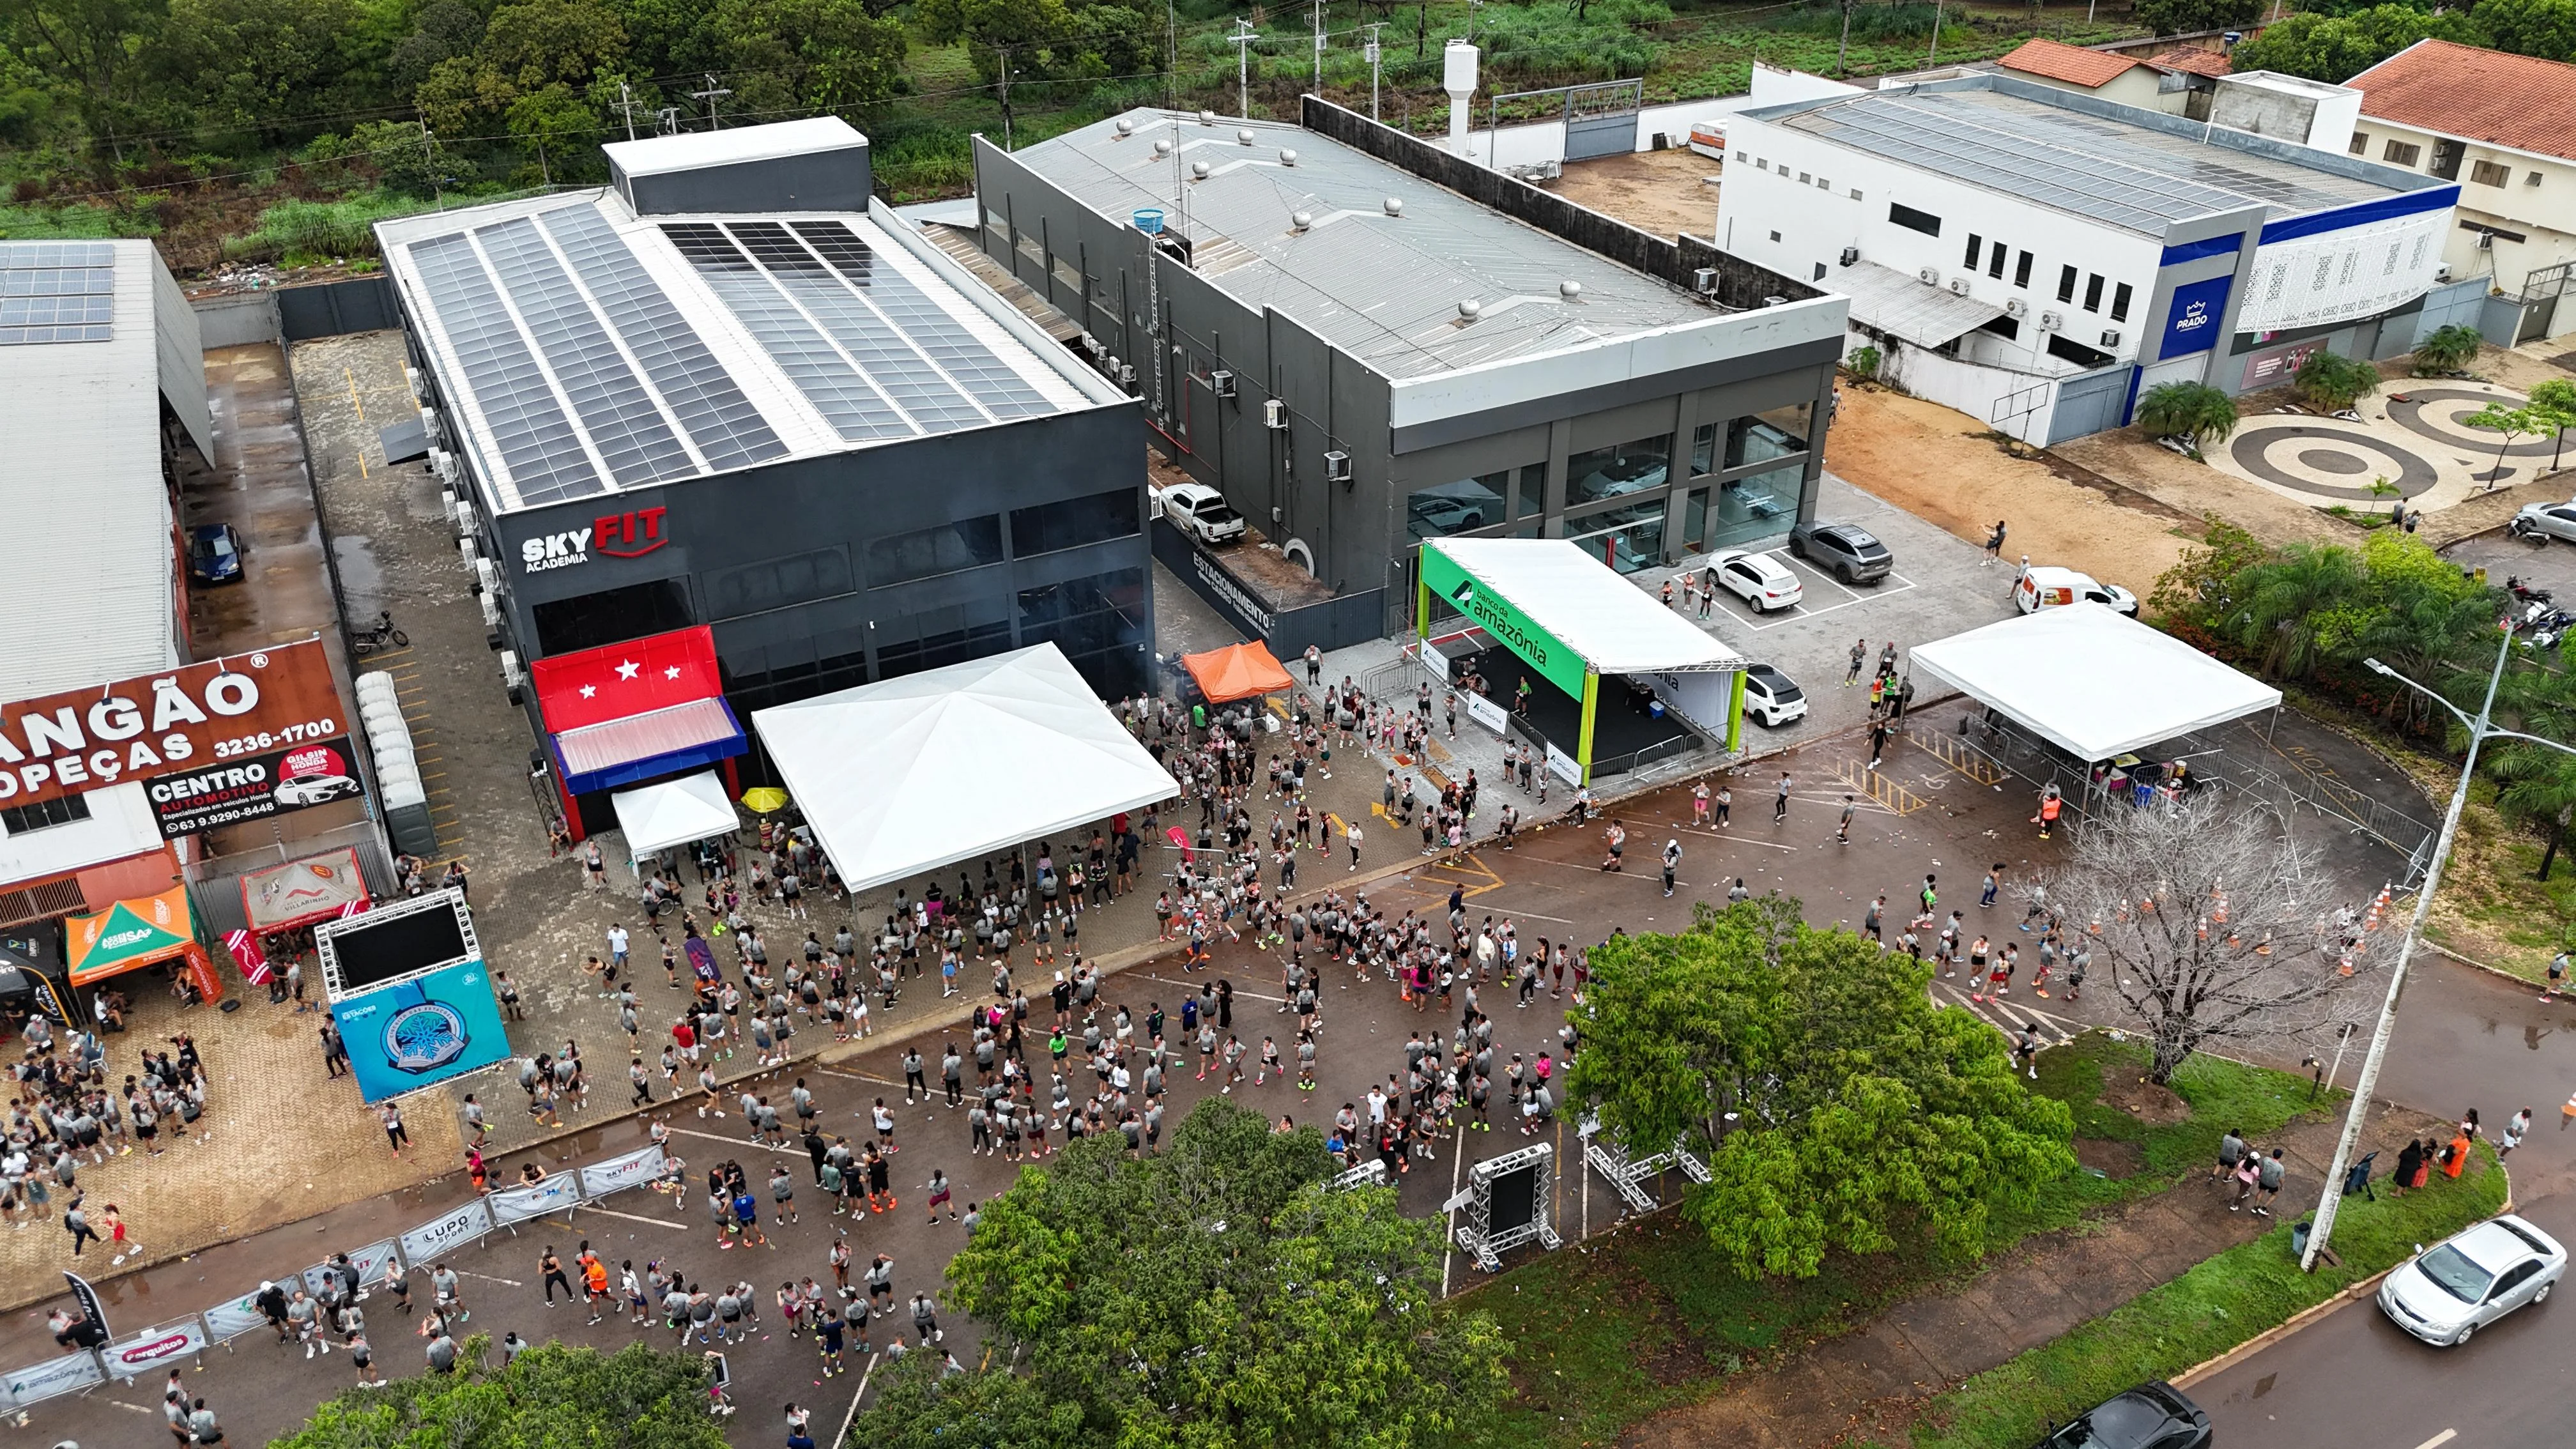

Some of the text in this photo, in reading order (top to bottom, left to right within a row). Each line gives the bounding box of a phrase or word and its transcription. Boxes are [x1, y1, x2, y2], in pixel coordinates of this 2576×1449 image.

[2176, 315, 2207, 330] PRADO
[526, 552, 588, 573] ACADEMIA
[1193, 551, 1269, 628] ESTACIONAMENTO
[1211, 581, 1232, 604] CARRO
[1476, 588, 1509, 618] banco da
[1474, 601, 1547, 667] amazônia
[214, 719, 335, 758] 3236-1700
[291, 758, 328, 771] HONDA
[151, 763, 266, 802] CENTRO
[160, 781, 269, 813] AUTOMOTIVO
[163, 806, 211, 820] Especializados
[250, 792, 272, 802] Honda
[180, 802, 275, 831] 63 9.9290-8448
[284, 896, 330, 911] VILLARINHO
[438, 1223, 470, 1243] SPORT
